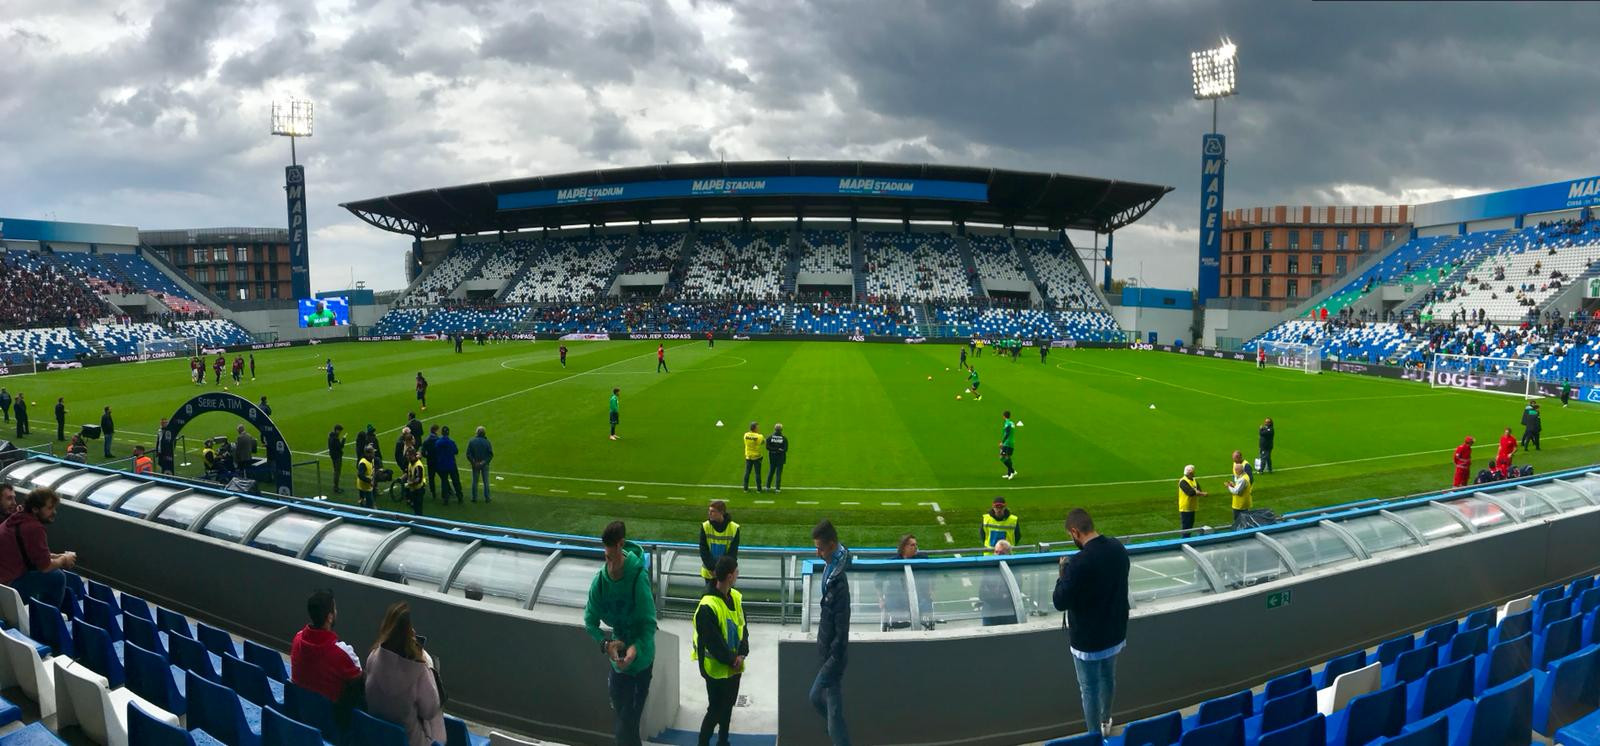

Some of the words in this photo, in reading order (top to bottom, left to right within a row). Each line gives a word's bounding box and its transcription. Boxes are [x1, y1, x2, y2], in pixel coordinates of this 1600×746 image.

[692, 179, 725, 191] MAPEI
[725, 181, 766, 190] STADIUM
[839, 179, 875, 190] MAPEI
[874, 181, 914, 192] STADIUM
[557, 187, 588, 200] MAPEI
[587, 187, 624, 197] STADIUM
[1205, 159, 1221, 246] MAPEI
[288, 185, 302, 256] MAPEI
[152, 351, 176, 359] COMPASS
[198, 398, 217, 408] SERIE
[218, 398, 226, 409] A
[228, 398, 242, 409] TIM
